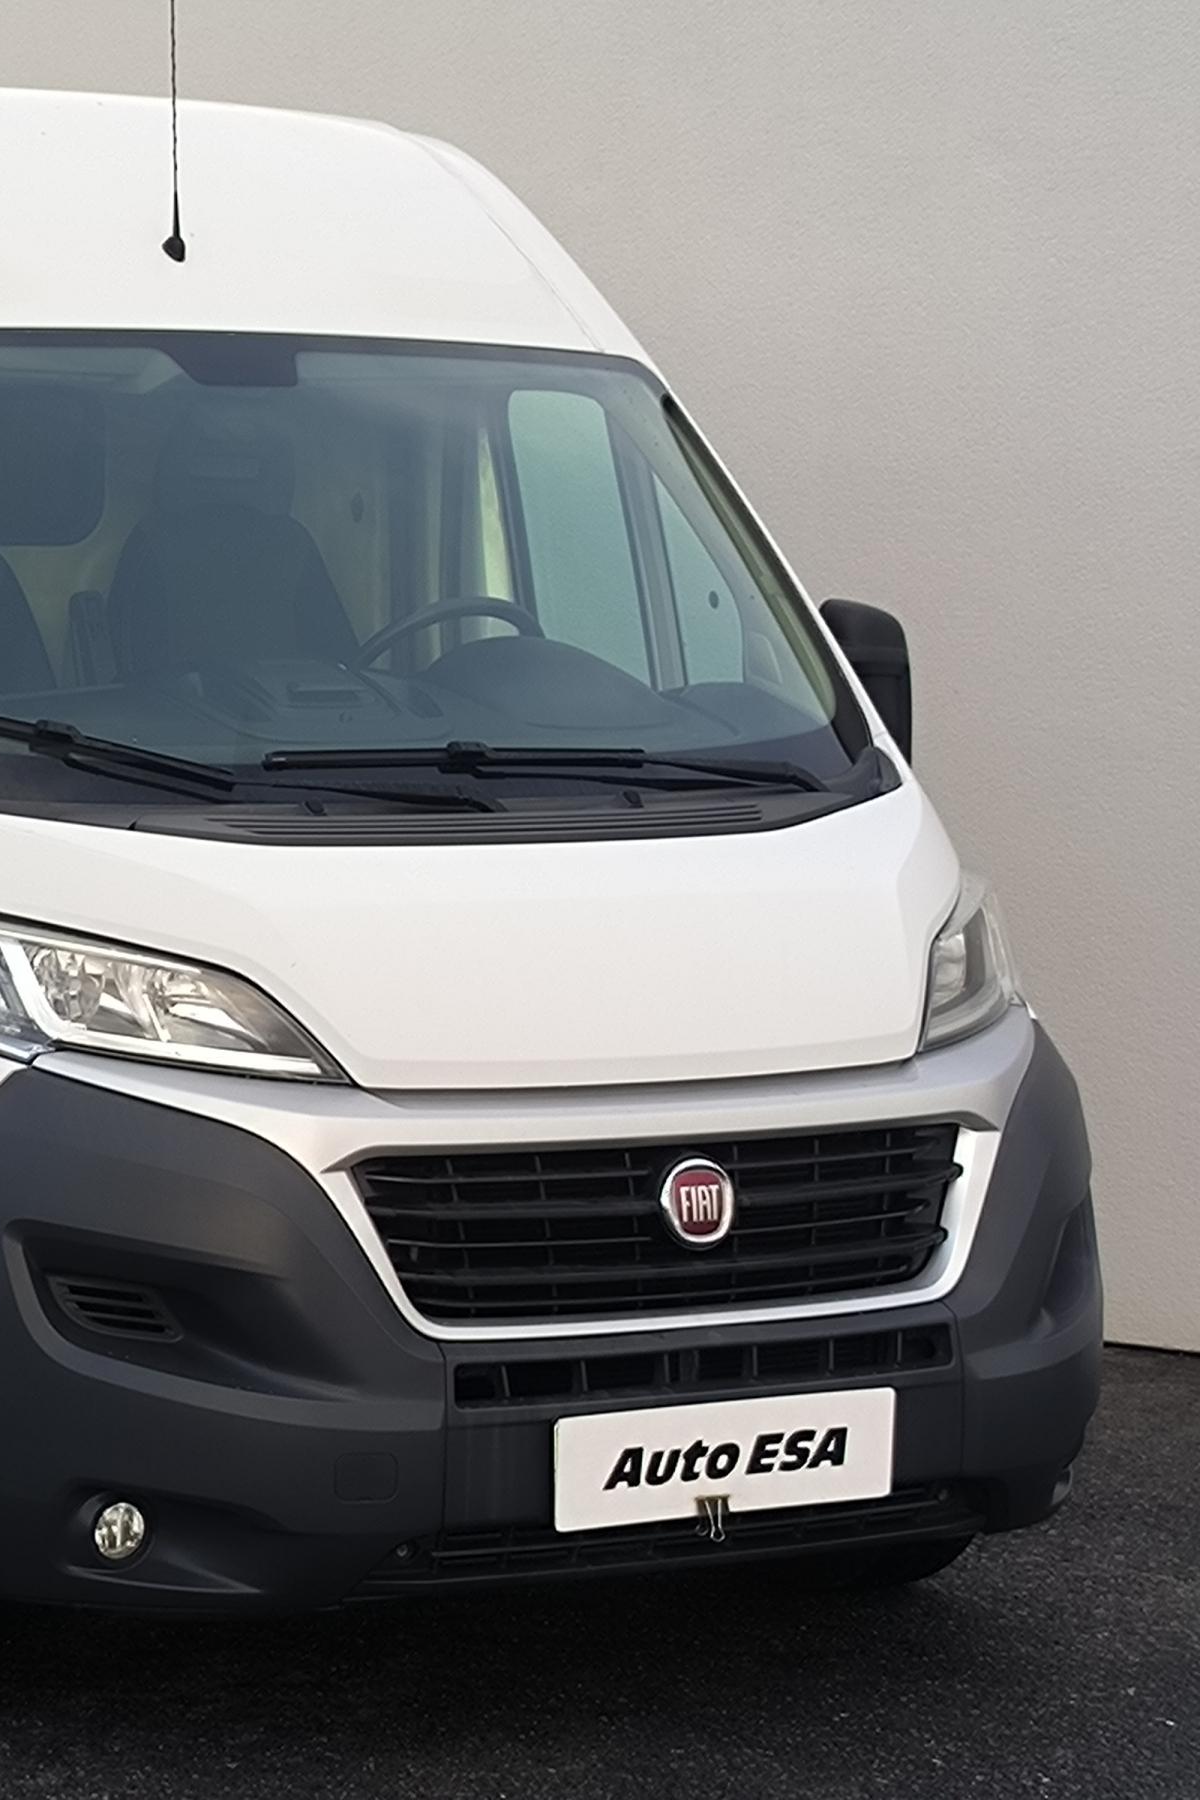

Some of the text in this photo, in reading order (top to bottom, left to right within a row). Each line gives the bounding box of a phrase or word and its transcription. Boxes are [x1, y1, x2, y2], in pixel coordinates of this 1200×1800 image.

[679, 1184, 720, 1223] FIAT
[603, 1426, 849, 1491] Auto ESA
